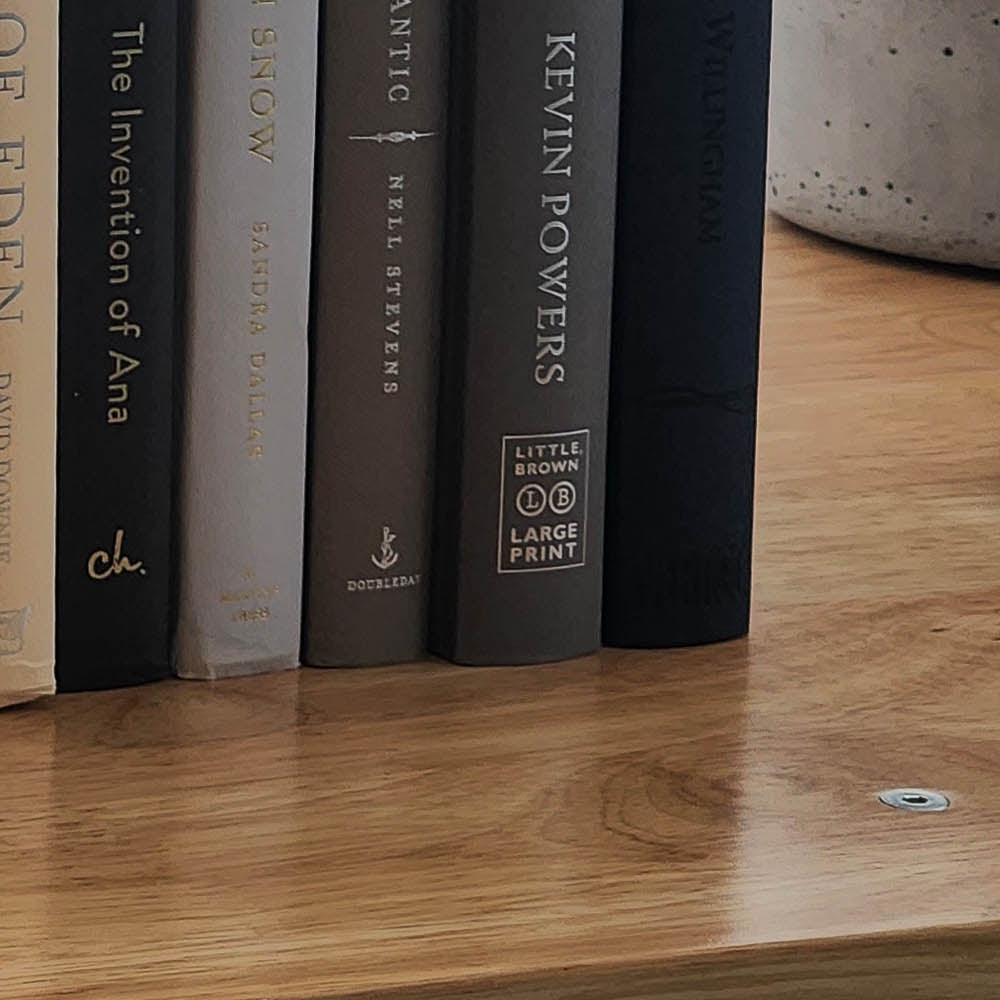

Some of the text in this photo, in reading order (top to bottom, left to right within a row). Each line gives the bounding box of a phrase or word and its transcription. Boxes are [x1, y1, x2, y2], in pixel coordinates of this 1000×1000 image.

[249, 27, 278, 164] SNOW
[106, 22, 144, 424] The Invention of Ana
[383, 175, 404, 394] NELL STEVENS
[533, 32, 576, 385] KEVIN POWERS
[246, 221, 270, 459] SANDRA DALLAS
[509, 542, 578, 563] PRINT
[510, 523, 579, 544] LARGE
[514, 458, 580, 476] BROWN
